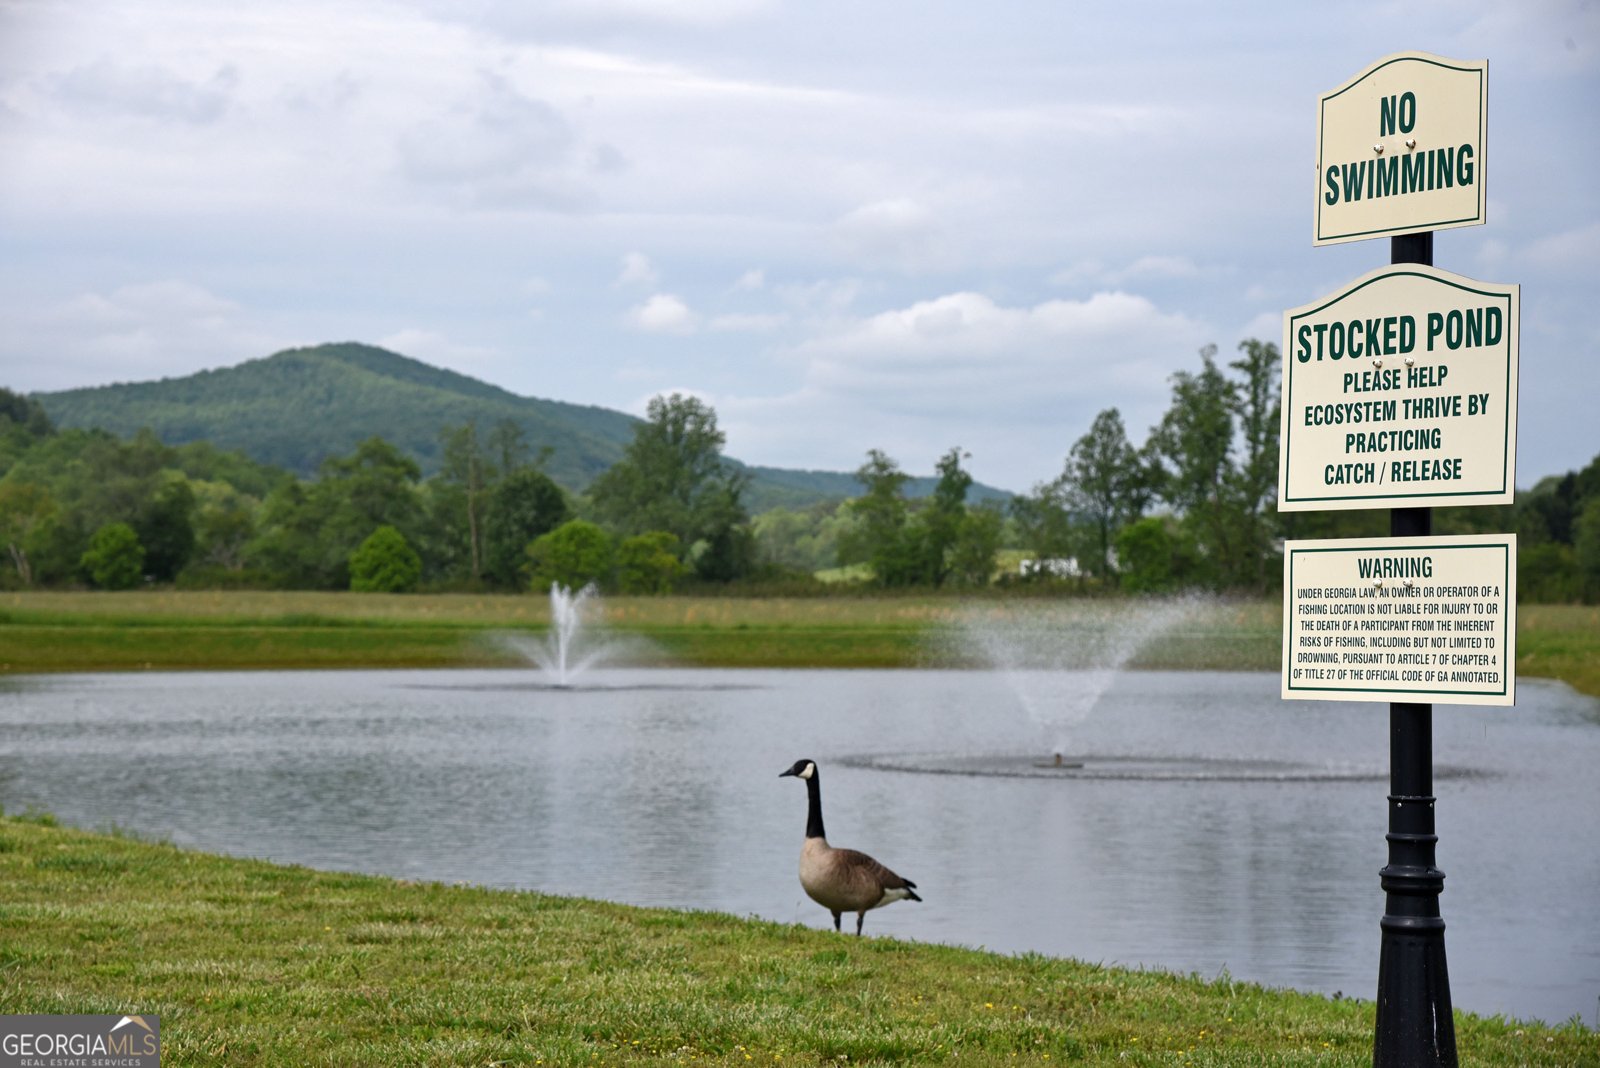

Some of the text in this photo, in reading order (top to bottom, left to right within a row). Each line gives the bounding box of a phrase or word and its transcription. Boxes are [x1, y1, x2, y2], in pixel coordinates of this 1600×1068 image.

[1380, 92, 1416, 137] NO
[1325, 144, 1473, 206] SWIMMING
[1297, 307, 1502, 363] STOCKED POND
[1344, 366, 1447, 393] PLEASE HELP
[1305, 394, 1489, 426] ECOSYSTEM THRIVE BY
[1346, 428, 1441, 453] PRACTICING
[1325, 463, 1374, 485] CATCH
[1391, 458, 1461, 482] RELEASE
[1358, 557, 1432, 578] WARNING
[1298, 586, 1499, 598] UNDER GEORGIA LAW, AN OWNER OR OPERATOR OF A
[1299, 604, 1498, 614] FISHING LOCATION IS NOT LIABLE FOR INJURY TO OR
[1301, 621, 1494, 631] THE DEATH OF A PARTICIPANT FROM THE INHERENT
[1300, 637, 1494, 648] RISKS OF FISHING, INCLUDING BUT NOT LIMITED TO
[1298, 653, 1496, 665] DROWNING, PURSUANT TO ARTICLE 7 OF CHAPTER 4
[1293, 669, 1501, 683] OF TITLE 27 OF THE OFFICIAL CODE OF GA ANNOTATED.
